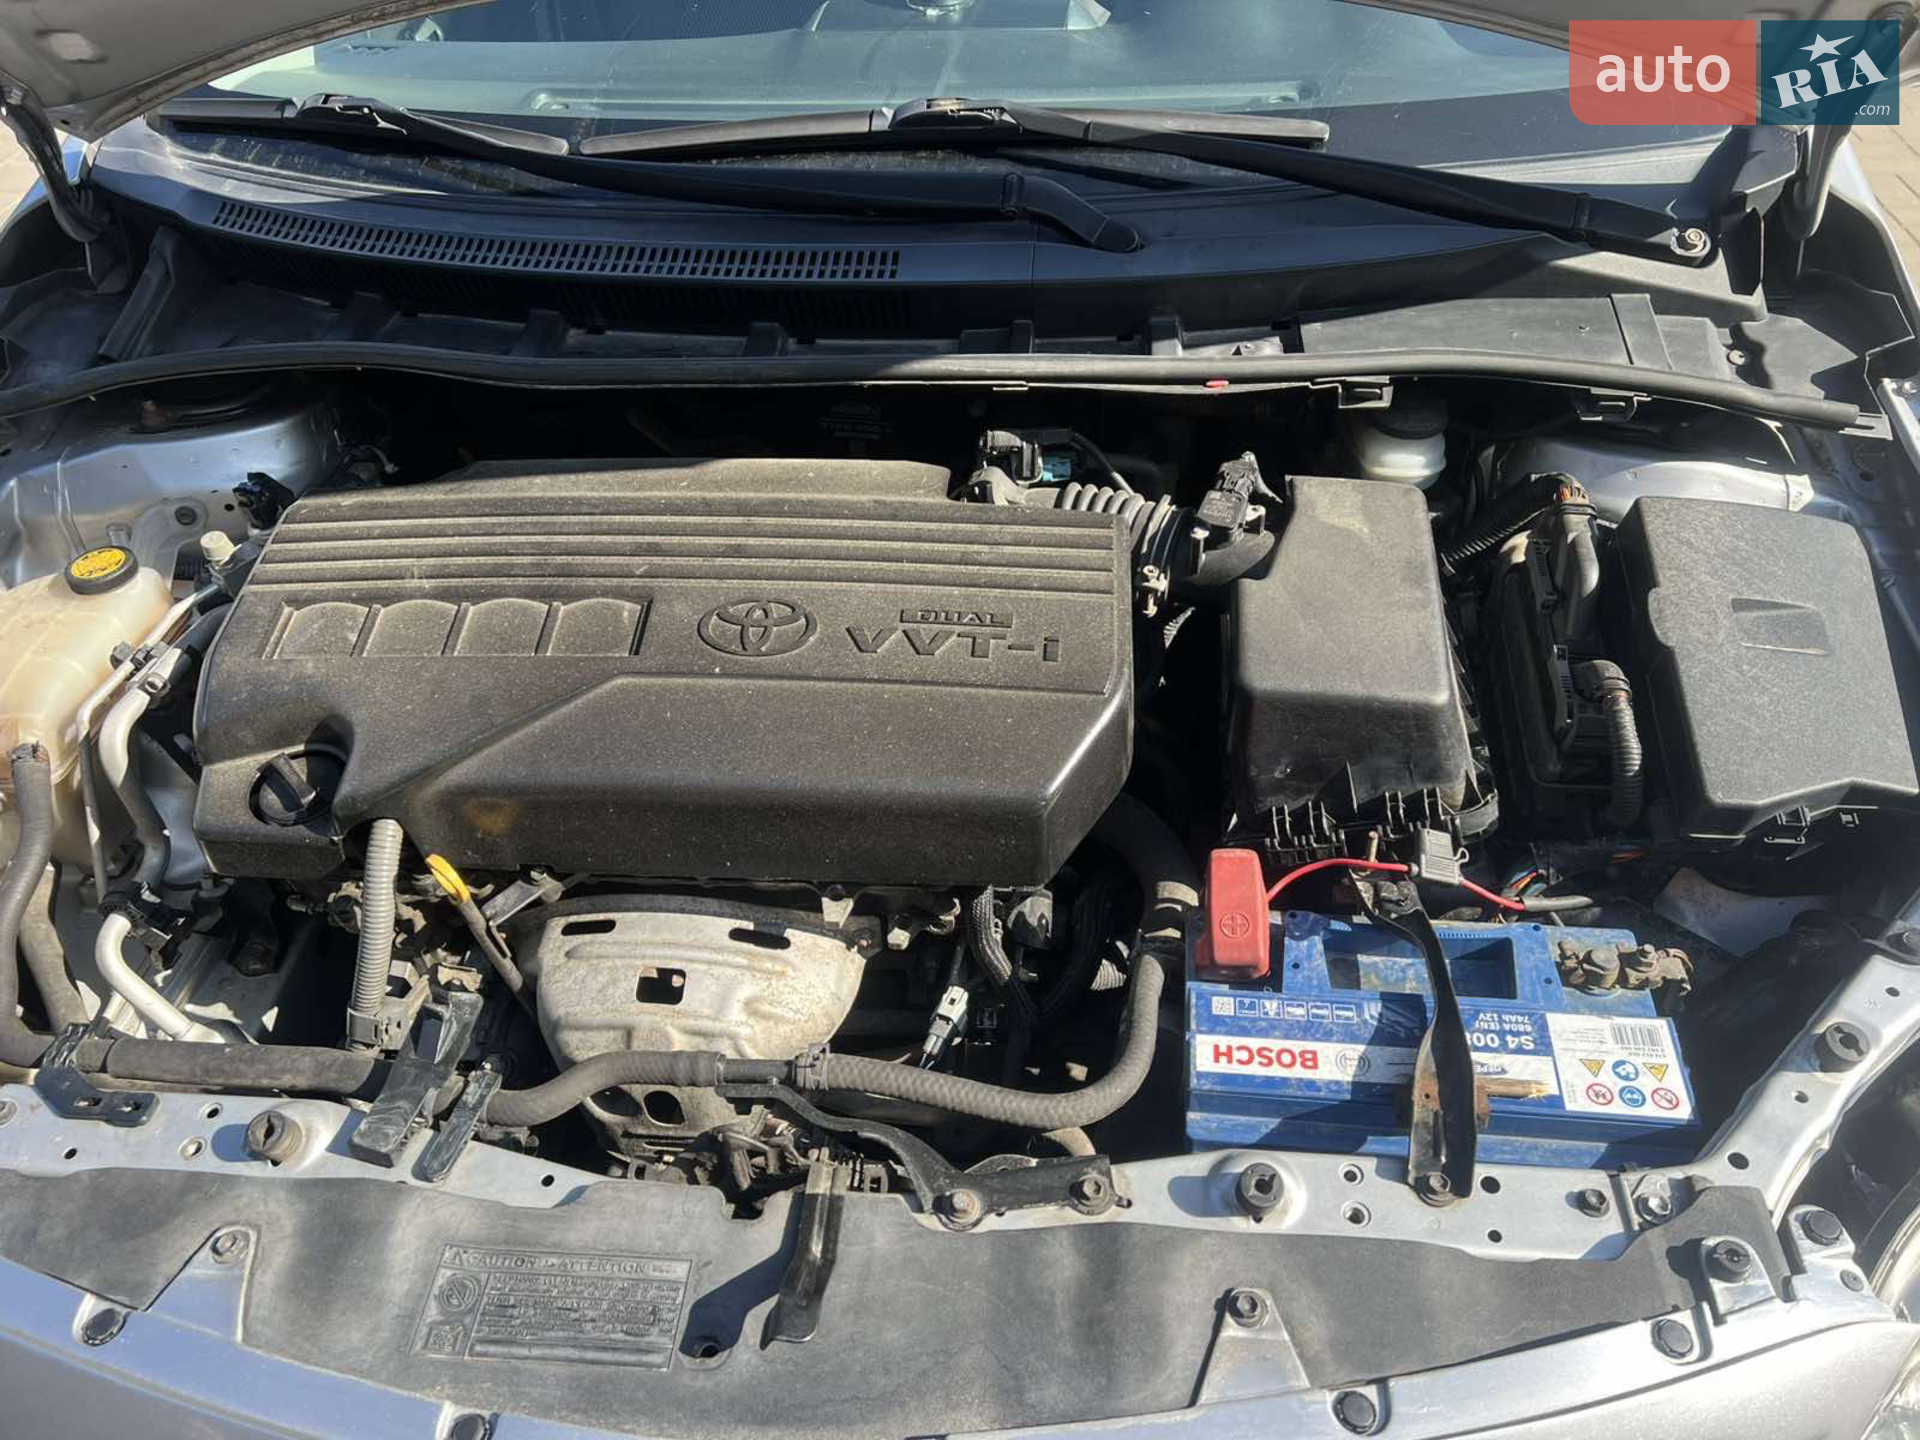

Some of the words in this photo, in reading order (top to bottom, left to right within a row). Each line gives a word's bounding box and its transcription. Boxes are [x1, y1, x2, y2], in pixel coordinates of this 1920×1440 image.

[918, 610, 1005, 625] DUAL
[1478, 1012, 1499, 1021] 12V
[1501, 1014, 1530, 1024] 74Ah
[1502, 1023, 1532, 1032] 680A
[1505, 1035, 1536, 1050] S4
[1213, 1043, 1319, 1071] BOSCH
[465, 1252, 538, 1269] CAUTION
[556, 1257, 646, 1275] ATTENTION
